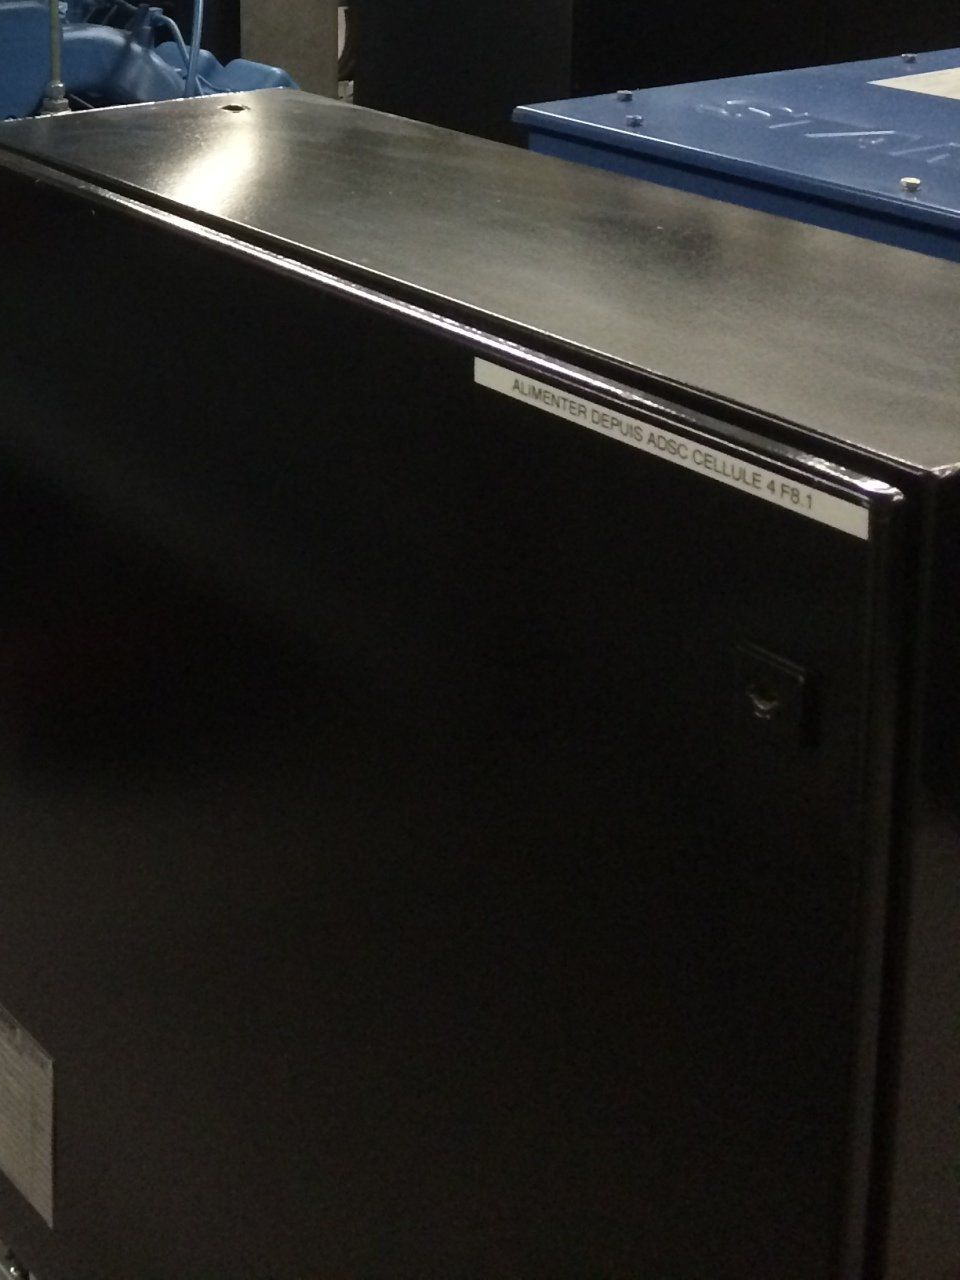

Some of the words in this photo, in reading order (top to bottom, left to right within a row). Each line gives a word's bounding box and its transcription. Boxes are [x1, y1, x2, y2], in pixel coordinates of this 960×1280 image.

[512, 378, 587, 419] ALIMENTER
[591, 409, 644, 442] DEPUIS
[647, 432, 689, 460] ADSC
[692, 449, 762, 490] CELLULE
[766, 479, 777, 496] 4
